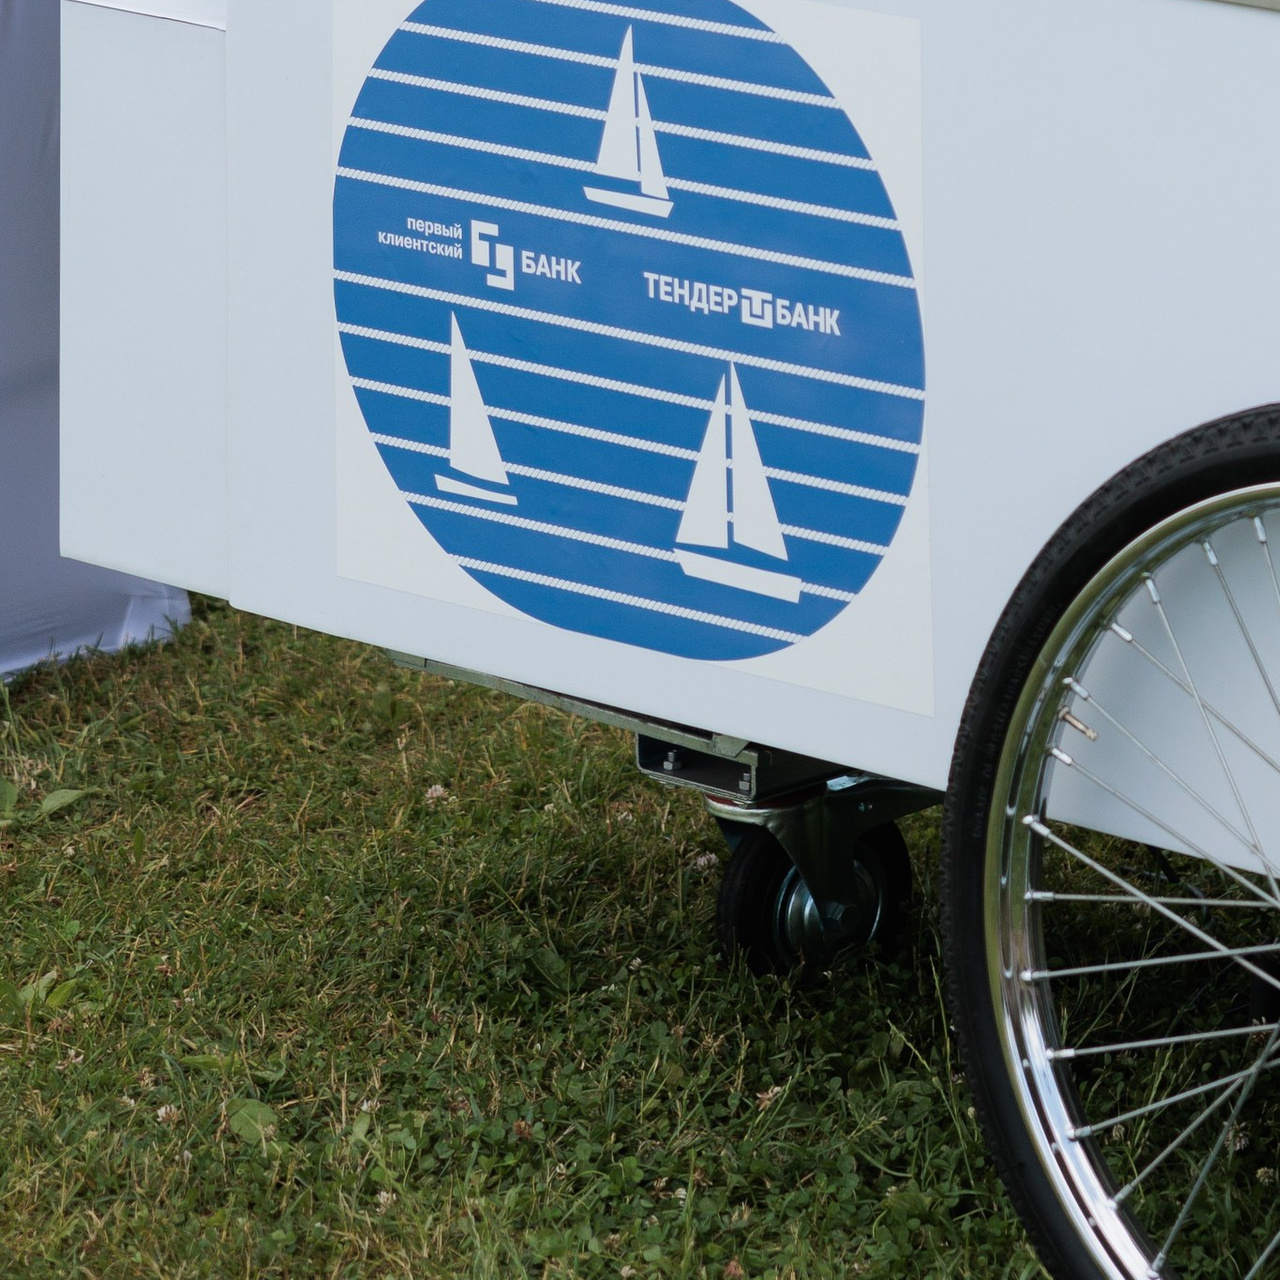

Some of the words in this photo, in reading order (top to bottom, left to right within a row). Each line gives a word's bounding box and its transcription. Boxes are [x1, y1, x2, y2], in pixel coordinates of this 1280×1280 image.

[407, 217, 462, 239] первый
[378, 231, 462, 259] клиентский
[521, 250, 581, 284] БАНК
[643, 271, 738, 315] ТЕНДЕР
[776, 298, 841, 336] БАНК
